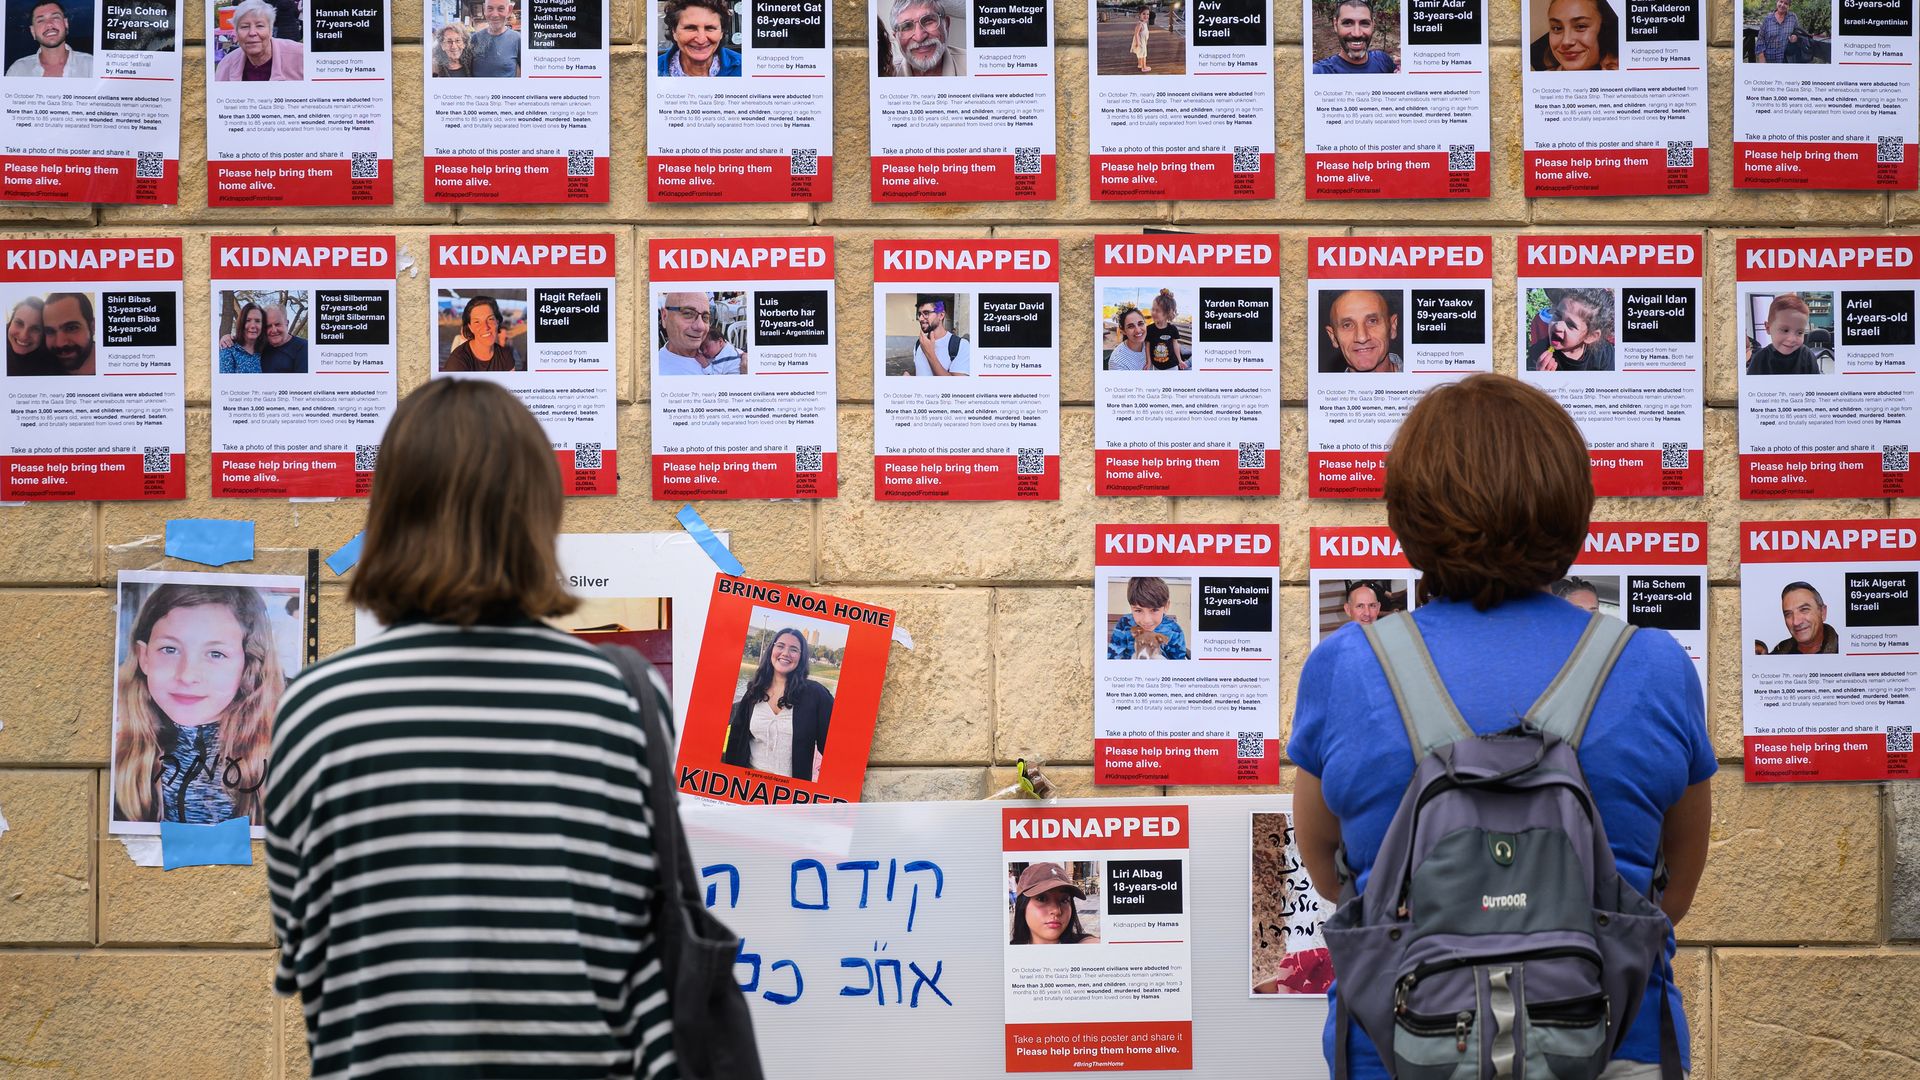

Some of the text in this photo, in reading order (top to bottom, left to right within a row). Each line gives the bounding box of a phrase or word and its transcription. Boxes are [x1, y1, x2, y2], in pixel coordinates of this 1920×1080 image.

[757, 3, 822, 12] Kinneret Gat
[1198, 1, 1221, 10] Aviv
[1413, 0, 1440, 8] Tamir
[1631, 4, 1690, 12] Dan Kalderon
[1844, 0, 1900, 9] 63-years-old
[108, 6, 167, 17] Eliya Cohen
[316, 9, 349, 17] Hannah
[534, 6, 576, 14] 73-years-old
[979, 5, 1044, 15] Yoram Metzger
[757, 15, 820, 27] 68-years-old
[979, 16, 1033, 26] 80-years-old
[1198, 14, 1260, 26] 2-years-old
[1413, 11, 1473, 22] 38-years-old
[1632, 15, 1685, 25] 16-years-old
[107, 18, 169, 29] 27-years-old
[316, 20, 370, 29] 77-years-old
[1844, 18, 1908, 26] Israeli-Argentinian
[979, 27, 1005, 35] Israeli
[1199, 28, 1230, 37] Israeli
[1413, 23, 1442, 32] Israeli
[1631, 26, 1658, 34] Israeli
[107, 31, 138, 40] Israeli
[316, 31, 342, 39] Israeli
[534, 31, 576, 40] 70-years-old
[757, 28, 788, 38] Israeli
[7, 248, 174, 269] KIDNAPPED
[221, 247, 388, 267] KIDNAPPED
[439, 245, 607, 265] KIDNAPPED
[659, 247, 826, 269] KIDNAPPED
[1105, 244, 1272, 264] KIDNAPPED
[1318, 246, 1484, 266] KIDNAPPED
[1528, 245, 1694, 264] KIDNAPPED
[1747, 247, 1913, 269] KIDNAPPED
[884, 250, 1051, 270] KIDNAPPED
[343, 294, 382, 302] Silberman
[540, 292, 601, 303] Hagit Refaeli
[760, 298, 779, 306] Luis
[1417, 298, 1473, 307] Yair Yaakov
[1627, 294, 1687, 306] Avigail Idan
[984, 302, 1044, 312] Evyatar David
[1205, 299, 1269, 307] Yarden Roman
[1846, 299, 1872, 309] Ariel
[108, 305, 156, 314] 33-years-old
[320, 304, 368, 313] 67-years-old
[540, 305, 599, 315] 48-years-old
[760, 308, 816, 317] Norberto har
[1628, 307, 1685, 319] 3-years-old
[137, 315, 160, 323] Bibas
[321, 313, 385, 322] Margit Silberman
[984, 313, 1038, 323] 22-years-old
[1205, 310, 1259, 320] 36-years-old
[1417, 310, 1476, 321] 59-years-old
[1847, 312, 1907, 325] 4-years-old
[540, 317, 569, 326] Israeli
[760, 319, 816, 330] 70-years-old
[1205, 321, 1231, 329] Israeli
[1417, 322, 1446, 331] Israeli
[1628, 320, 1658, 329] Israeli
[108, 325, 157, 334] 34-years-old
[321, 323, 368, 332] 63-years-old
[760, 328, 780, 336] Israeli
[786, 329, 825, 337] Argentinian
[984, 324, 1010, 332] Israeli
[1847, 326, 1880, 336] Israeli
[108, 335, 132, 343] Israeli
[1105, 534, 1271, 554] KIDNAPPED
[1584, 532, 1700, 552] NAPPED
[1750, 529, 1916, 550] KIDNAPPED
[569, 575, 609, 587] Silver
[1633, 580, 1685, 589] Mia Schem
[1851, 579, 1906, 589] Itzik Algerat
[1204, 586, 1269, 594] Eitan Yahalomi
[1633, 592, 1692, 603] 21-years-old
[1851, 590, 1908, 601] 69-years-old
[718, 579, 891, 627] BRING NOA HOME
[1204, 597, 1258, 606] 12-years-old
[1851, 602, 1879, 611] Israeli
[1204, 608, 1231, 616] Israeli
[1633, 604, 1662, 613] Israeli
[679, 766, 849, 805] KIDNAPP
[1010, 816, 1180, 839] KIDNAPPED
[1113, 869, 1162, 880] Liri Albag
[1113, 881, 1177, 893] 18-years-old
[791, 858, 944, 932] קודם
[1113, 894, 1144, 904] Israeli
[1482, 893, 1527, 908] OUTDOOR
[1113, 921, 1147, 929] Kidnapped
[1013, 1034, 1034, 1044] Take
[1044, 1034, 1070, 1047] photo
[1071, 1034, 1081, 1042] of
[1082, 1033, 1099, 1042] this
[1100, 1034, 1129, 1045] poster
[1131, 1033, 1149, 1042] and
[1150, 1033, 1175, 1041] share
[1177, 1033, 1183, 1041] it
[1016, 1045, 1180, 1057] Please help bring them home alive.
